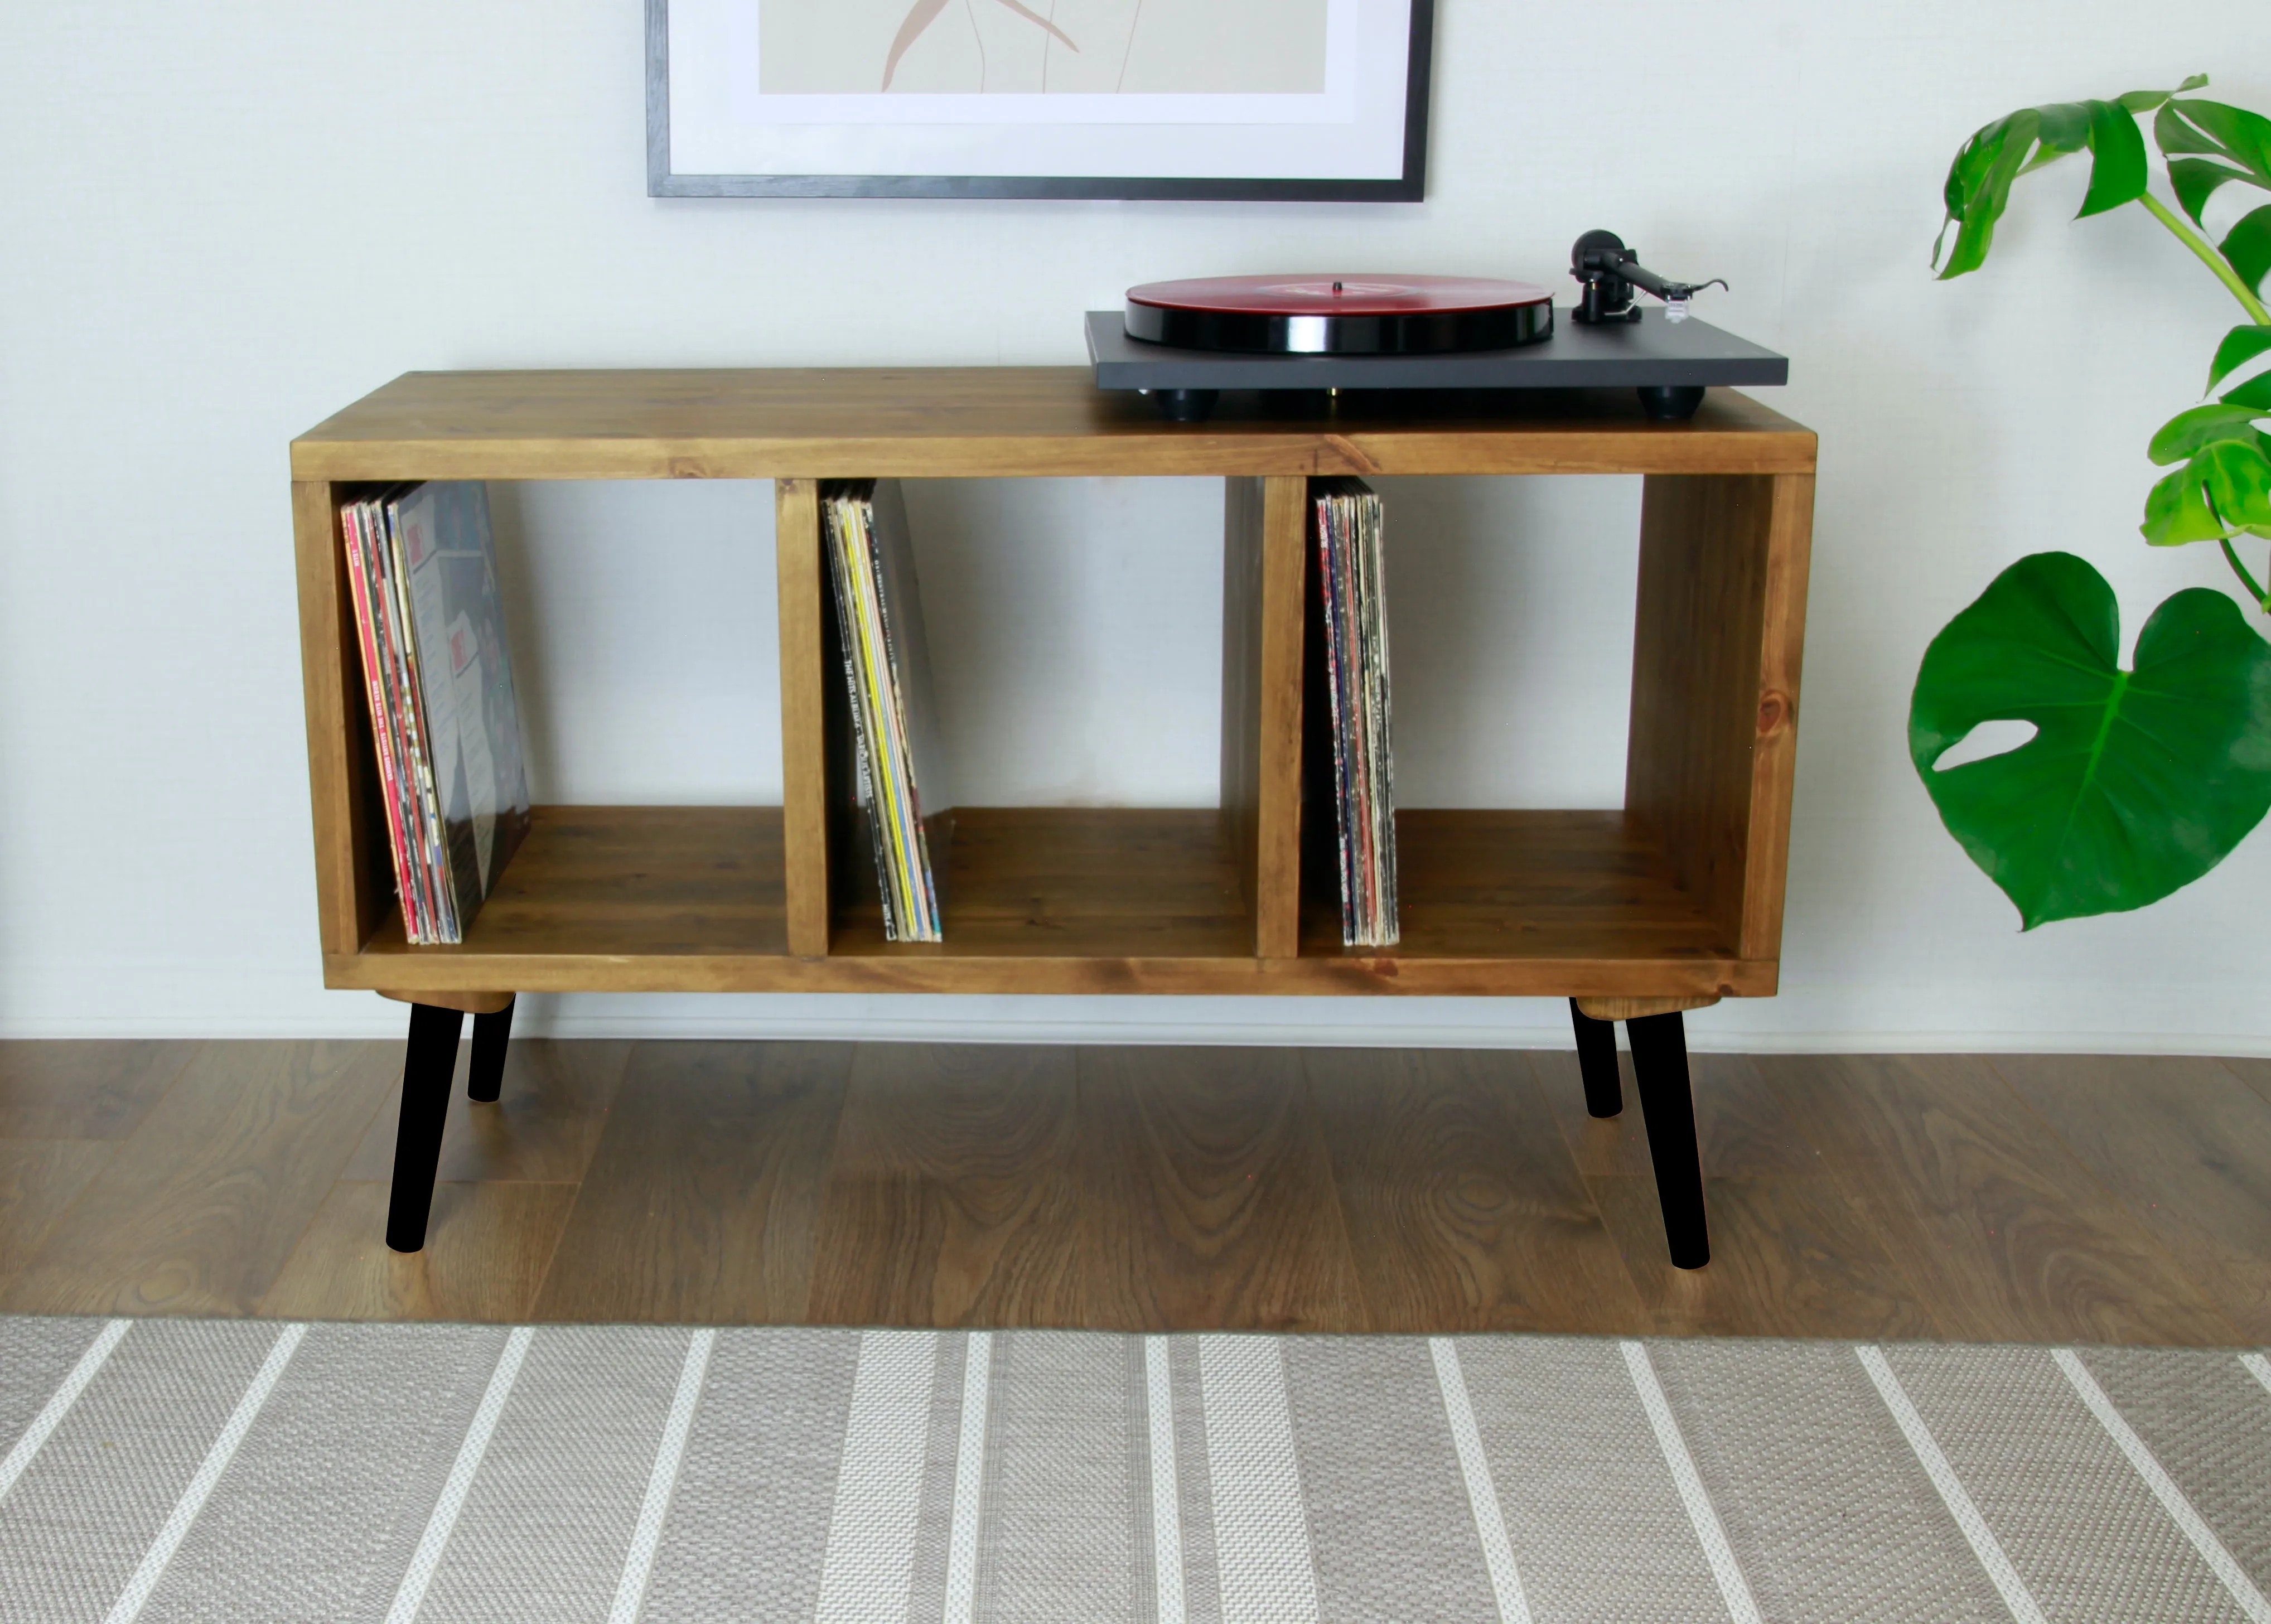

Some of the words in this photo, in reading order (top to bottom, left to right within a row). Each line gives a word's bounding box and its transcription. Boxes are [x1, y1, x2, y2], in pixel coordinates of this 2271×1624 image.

[844, 659, 854, 675] THE
[847, 676, 857, 693] HITS
[380, 732, 389, 756] ARTISTS
[857, 734, 868, 768] VARIOUS
[862, 770, 873, 798] ARTISTS
